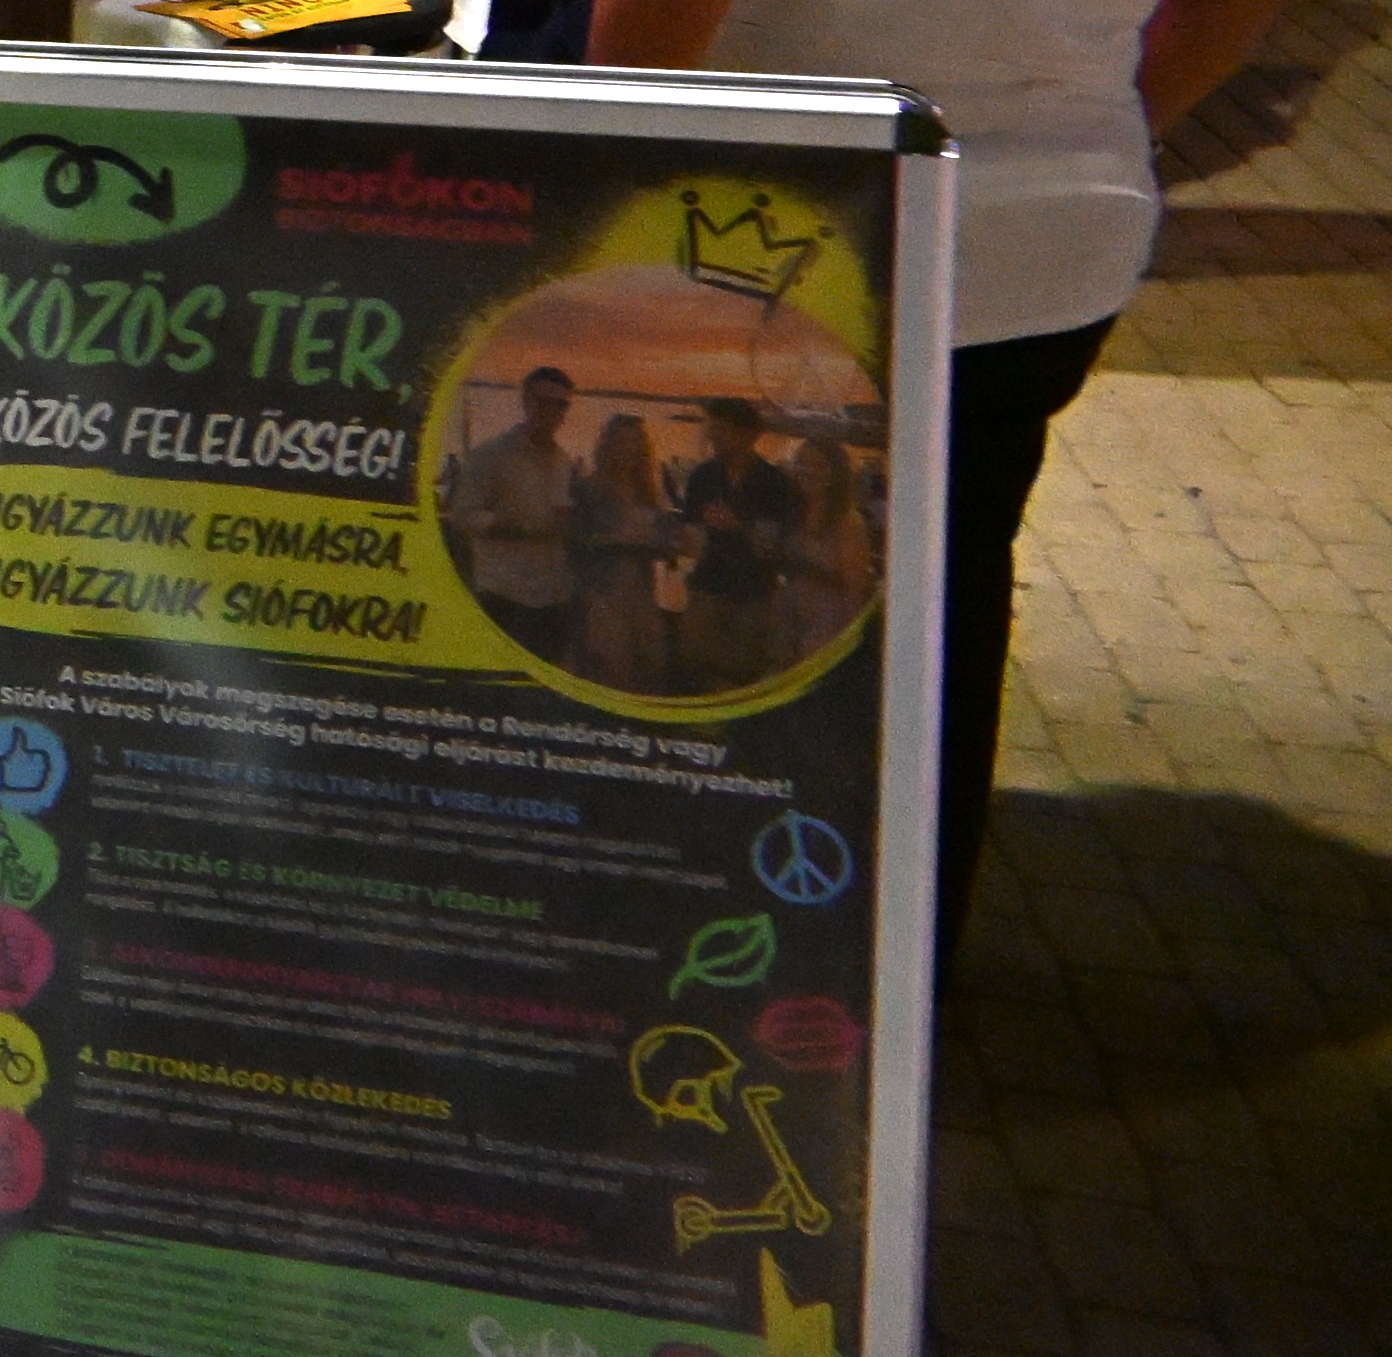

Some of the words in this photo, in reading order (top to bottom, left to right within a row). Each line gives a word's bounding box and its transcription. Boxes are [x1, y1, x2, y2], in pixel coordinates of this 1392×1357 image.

[120, 409, 406, 480] FELELŐSSÉG!
[222, 579, 428, 644] SIÓFOKRA!
[57, 664, 77, 684] A
[80, 695, 154, 722] Város
